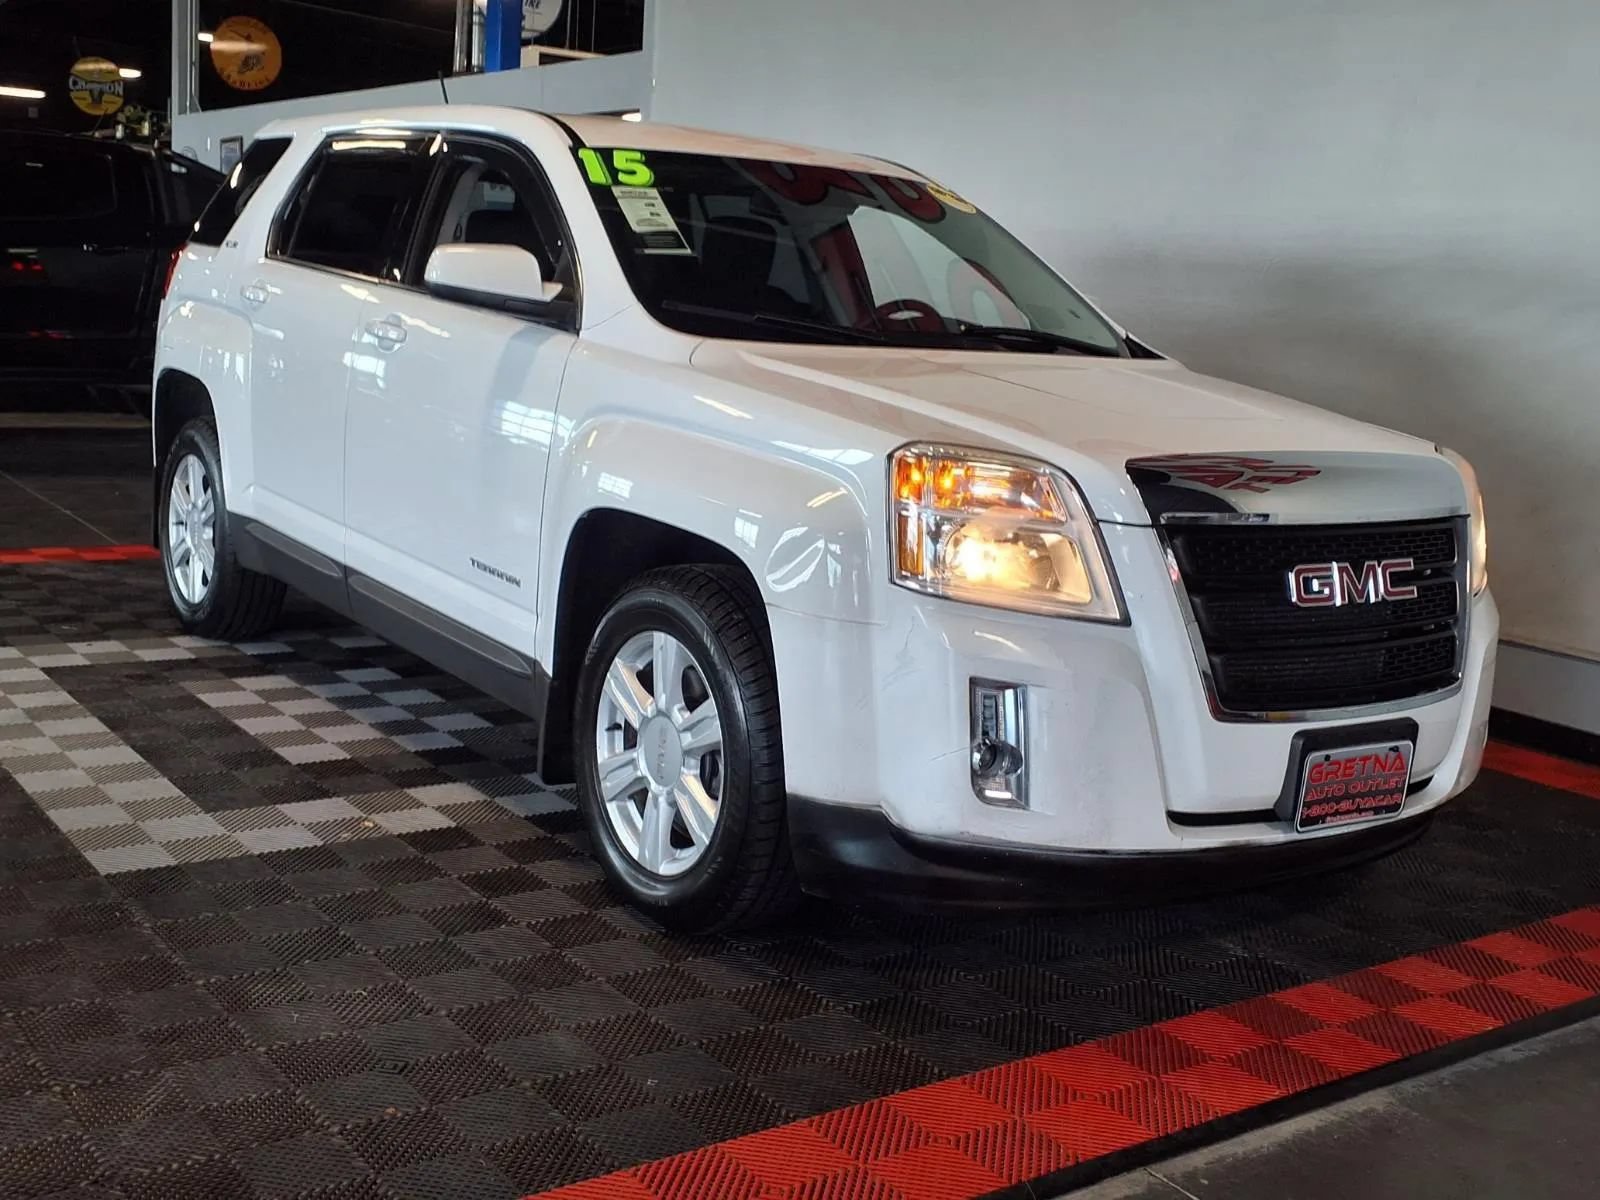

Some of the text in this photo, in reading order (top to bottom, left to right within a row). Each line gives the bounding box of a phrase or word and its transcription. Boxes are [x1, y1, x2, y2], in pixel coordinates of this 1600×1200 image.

[578, 147, 654, 186] 15
[1288, 558, 1417, 607] GMC
[1309, 751, 1407, 785] GRETNA
[1306, 775, 1407, 801] AUTO OUTLET
